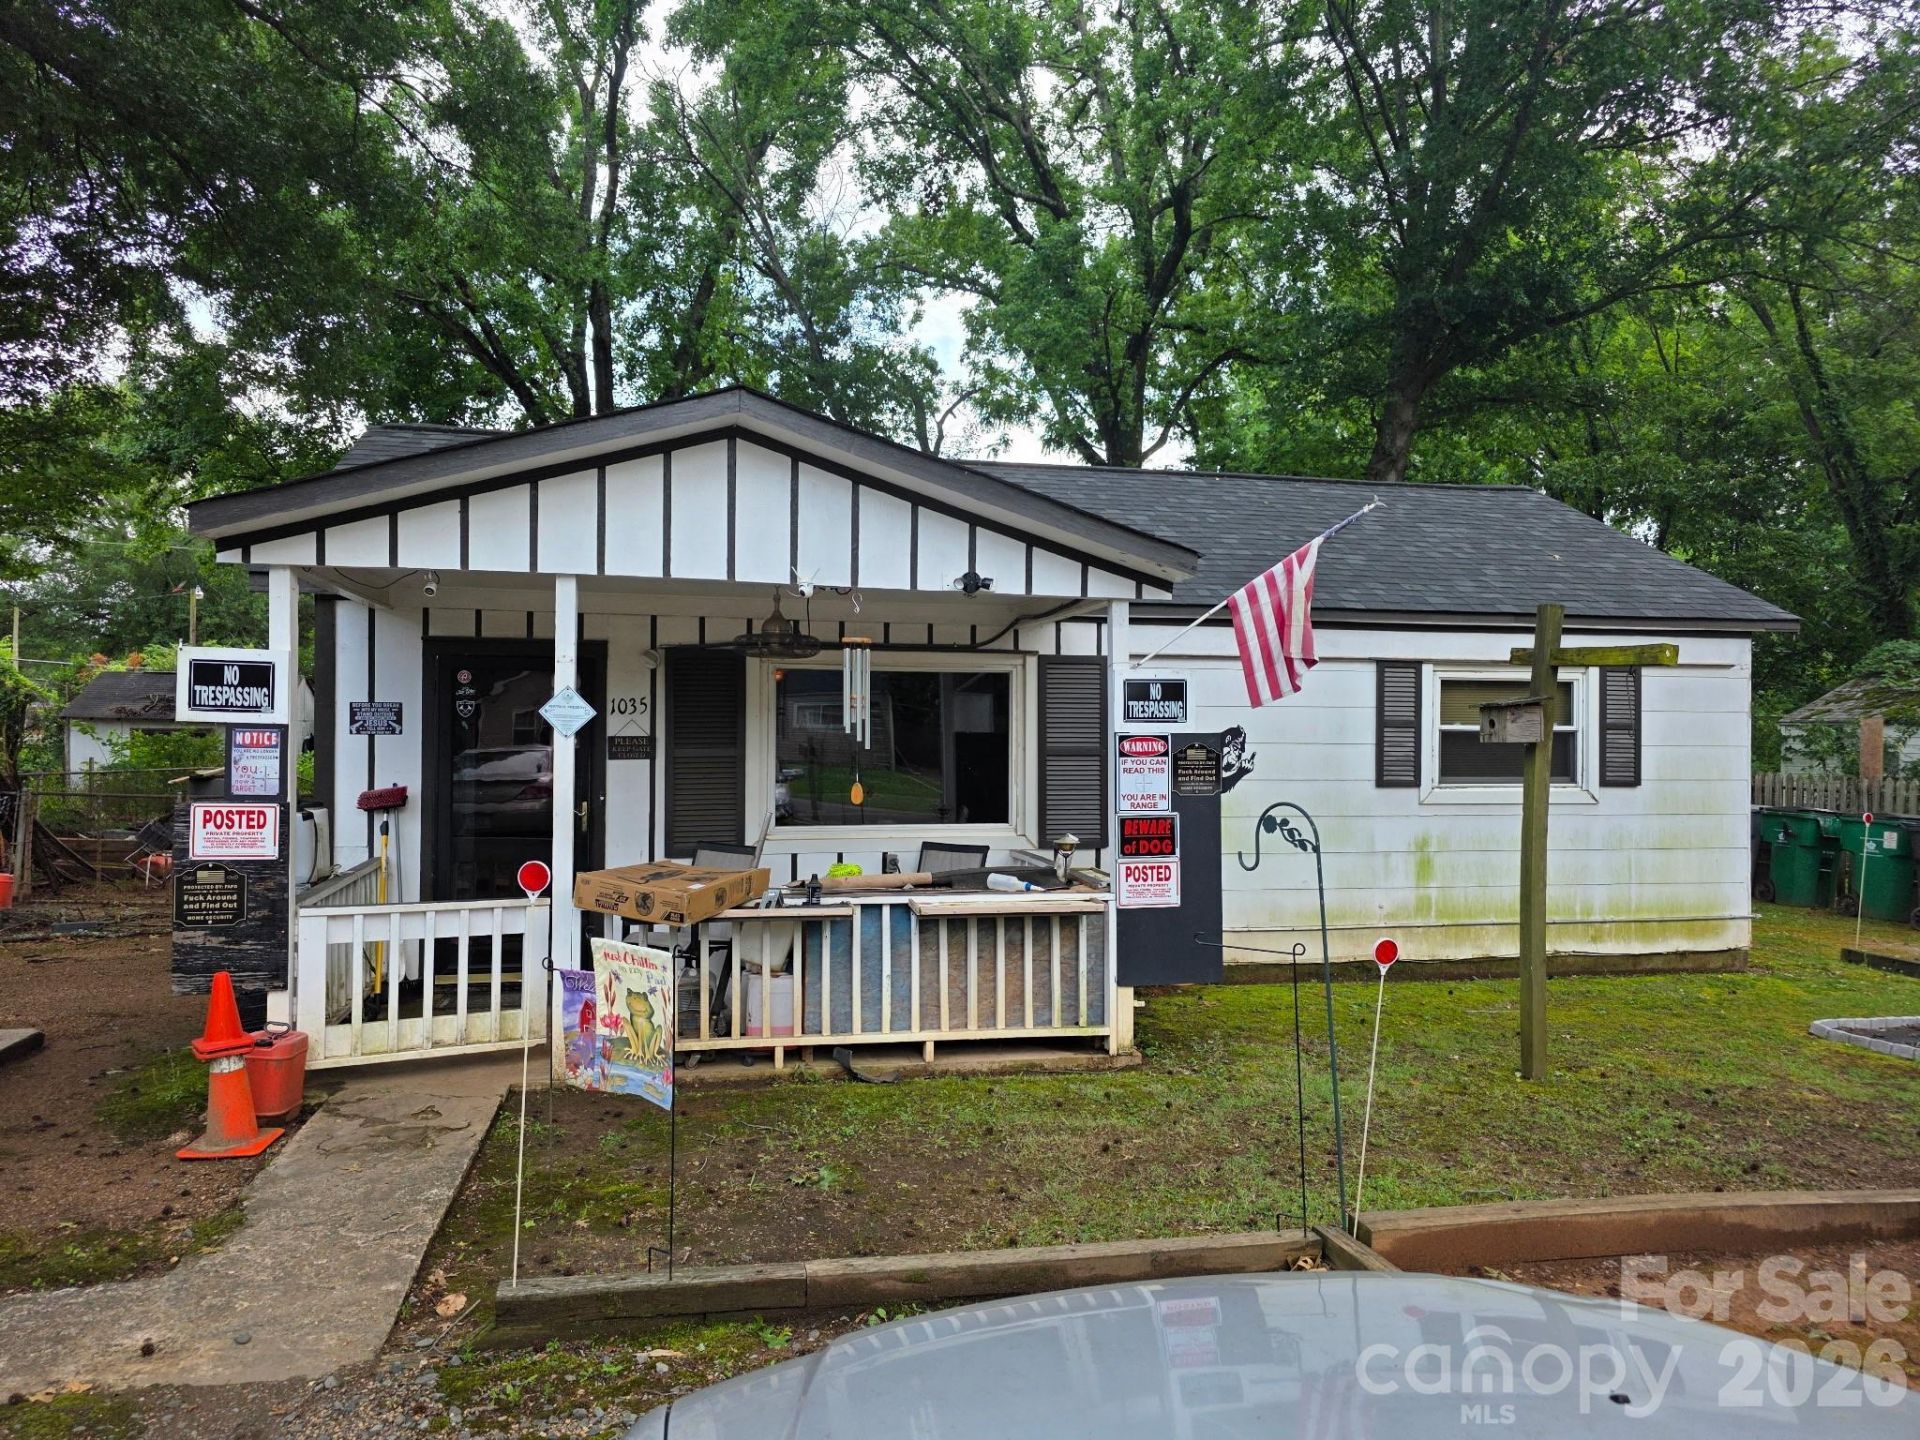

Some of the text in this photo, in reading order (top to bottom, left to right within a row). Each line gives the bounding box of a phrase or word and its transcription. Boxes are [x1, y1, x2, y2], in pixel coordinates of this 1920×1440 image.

[224, 665, 240, 686] NO
[194, 685, 269, 707] TRESPASSING
[1150, 683, 1162, 700] NO
[610, 696, 648, 716] 1035
[1128, 701, 1184, 718] TRESPASSING
[236, 731, 279, 745] NOTICE
[615, 737, 648, 745] PLEASE
[1123, 741, 1165, 752] WARNING
[233, 766, 258, 774] YOU
[202, 809, 267, 830] POSTED
[1124, 819, 1172, 835] BEWARE
[1124, 840, 1173, 854] of DOG
[1125, 865, 1172, 883] POSTED
[646, 971, 667, 986] Pad
